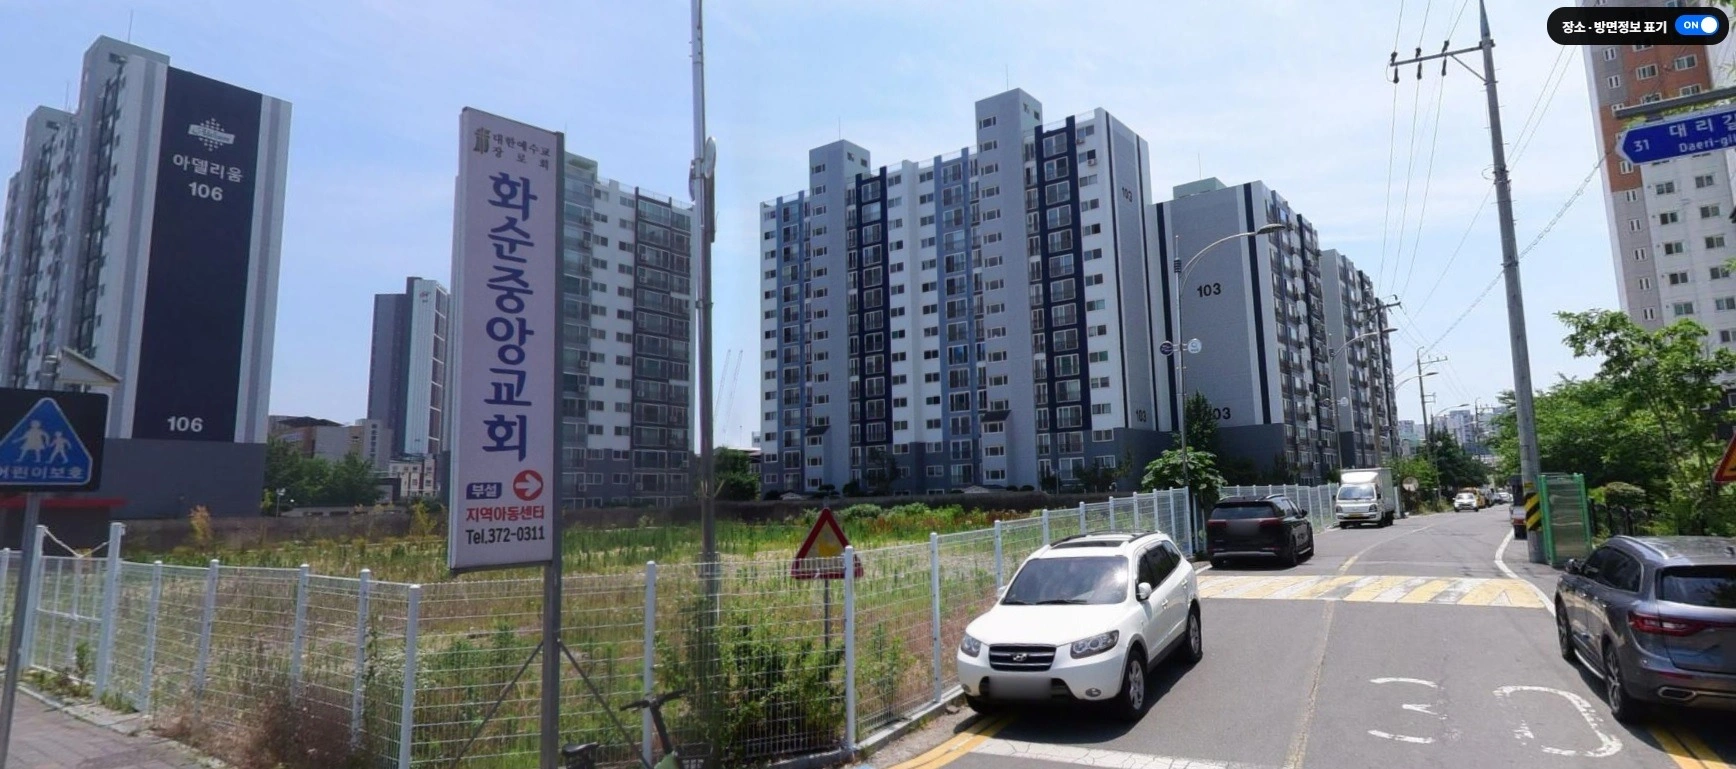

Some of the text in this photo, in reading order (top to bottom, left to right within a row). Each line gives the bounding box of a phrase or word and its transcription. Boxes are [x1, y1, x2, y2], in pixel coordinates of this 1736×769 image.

[493, 133, 550, 157] 대한예수교
[1633, 138, 1650, 153] 31
[172, 154, 244, 183] 아델리움
[188, 181, 223, 201] 106
[1196, 282, 1221, 298] 103
[481, 171, 538, 463] 화순중앙교회
[1136, 409, 1147, 423] 103
[1212, 406, 1232, 420] 03
[167, 416, 204, 432] 106
[0, 465, 84, 480] 어린이보호
[471, 483, 498, 498] 부설
[466, 505, 545, 523] 지역아동센터
[465, 525, 545, 545] Tel.372-0311
[1367, 677, 1623, 757] 30
